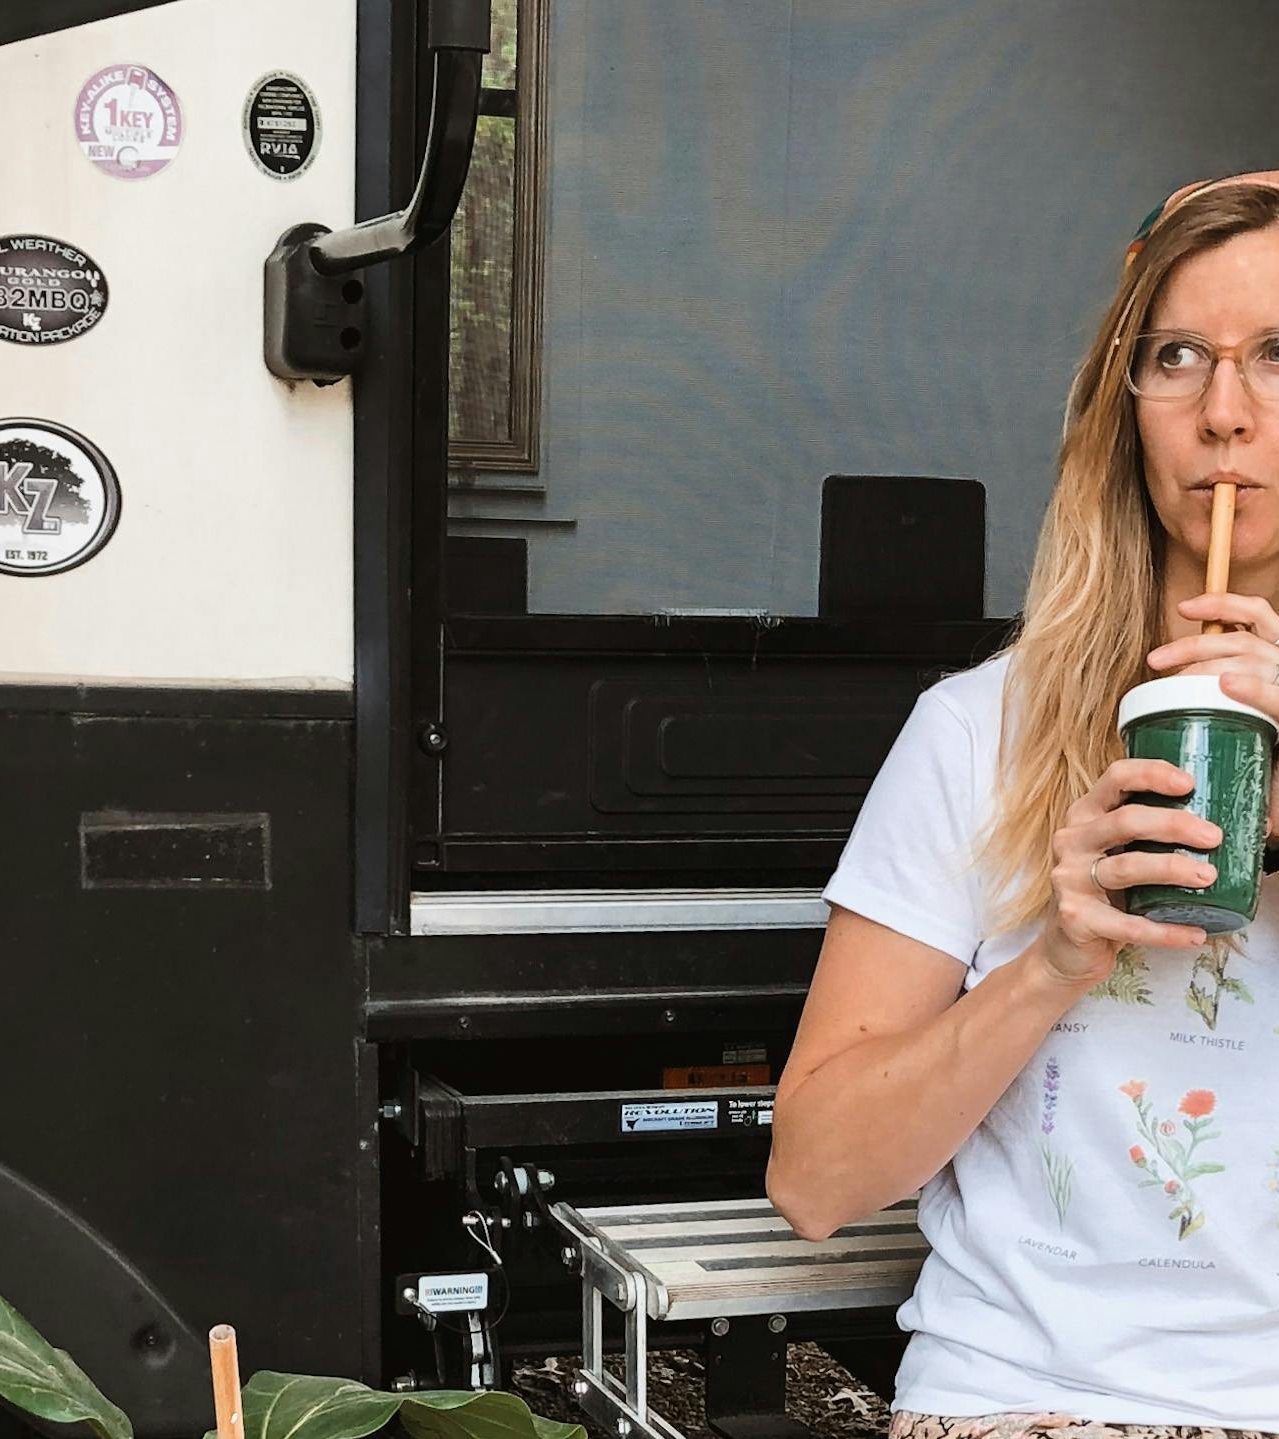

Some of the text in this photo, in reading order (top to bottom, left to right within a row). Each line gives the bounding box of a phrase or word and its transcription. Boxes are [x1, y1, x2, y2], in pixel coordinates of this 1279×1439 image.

[104, 98, 153, 128] 1 KEY
[146, 79, 178, 141] SYSTEM
[88, 145, 115, 157] NEW
[260, 141, 298, 155] RVIA
[9, 238, 87, 267] WEATHER
[7, 276, 61, 286] GOLD
[40, 306, 101, 342] PACKAGE
[5, 549, 49, 561] EST. 1972
[1169, 1031, 1245, 1051] MILK THISTLE
[624, 1106, 716, 1116] REVOLUTION
[728, 1100, 737, 1108] To
[737, 1099, 756, 1109] lower
[1018, 1235, 1078, 1260] LAVENDAR
[1138, 1257, 1216, 1270] CALENDULA
